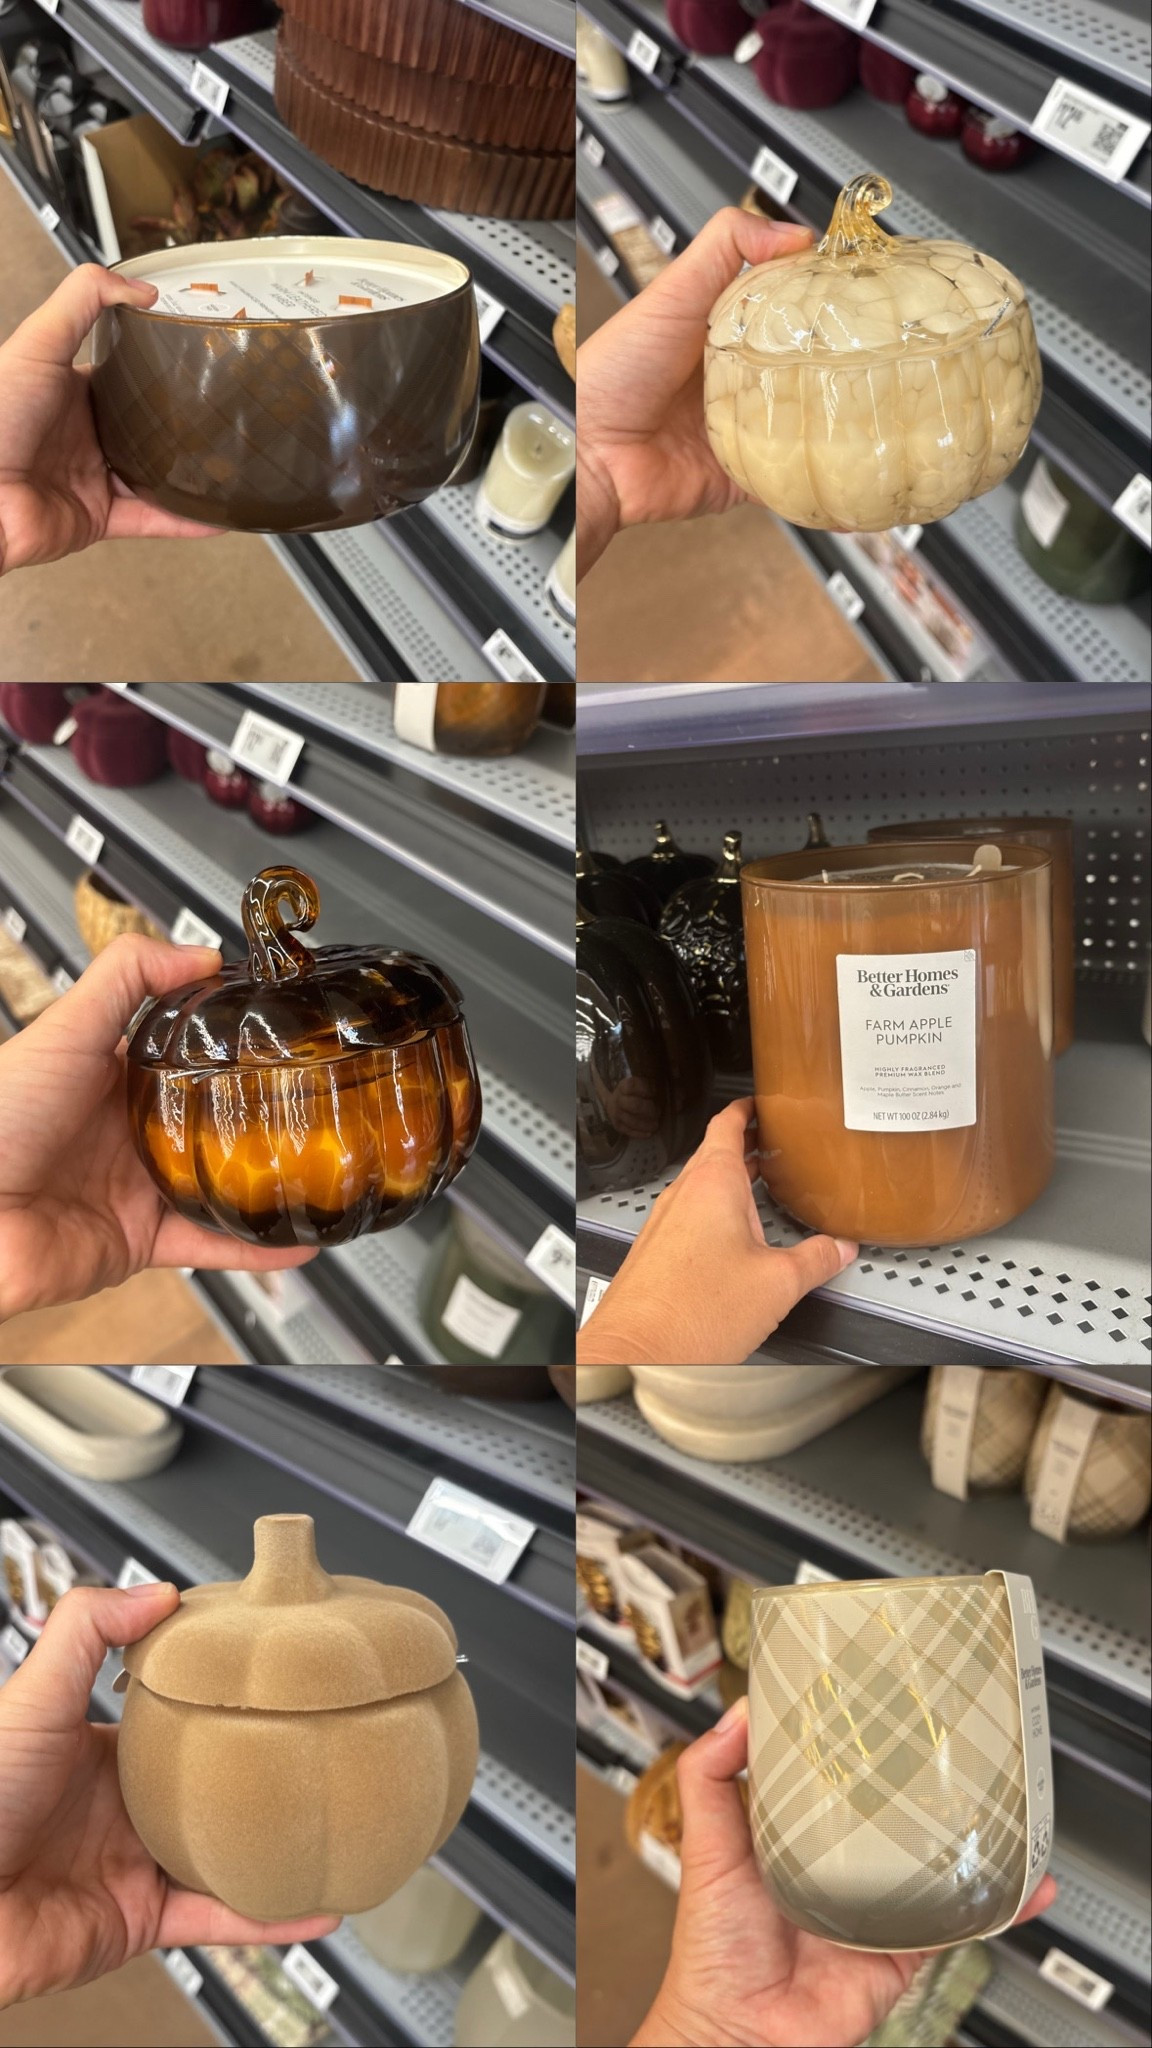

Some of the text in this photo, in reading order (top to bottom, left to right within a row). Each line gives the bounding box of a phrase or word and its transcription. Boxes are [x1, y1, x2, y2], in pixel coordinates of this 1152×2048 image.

[857, 968, 959, 983] Better Homes
[883, 982, 949, 998] Gardens
[865, 1016, 953, 1031] FARM APPLE
[876, 1032, 942, 1046] PUMPKIN
[900, 1064, 946, 1072] FRAGRANCED
[924, 1069, 946, 1077] BLEND
[930, 1083, 951, 1091] Orange
[873, 1108, 950, 1121] NET WT 100 OZ (2.84 kg)
